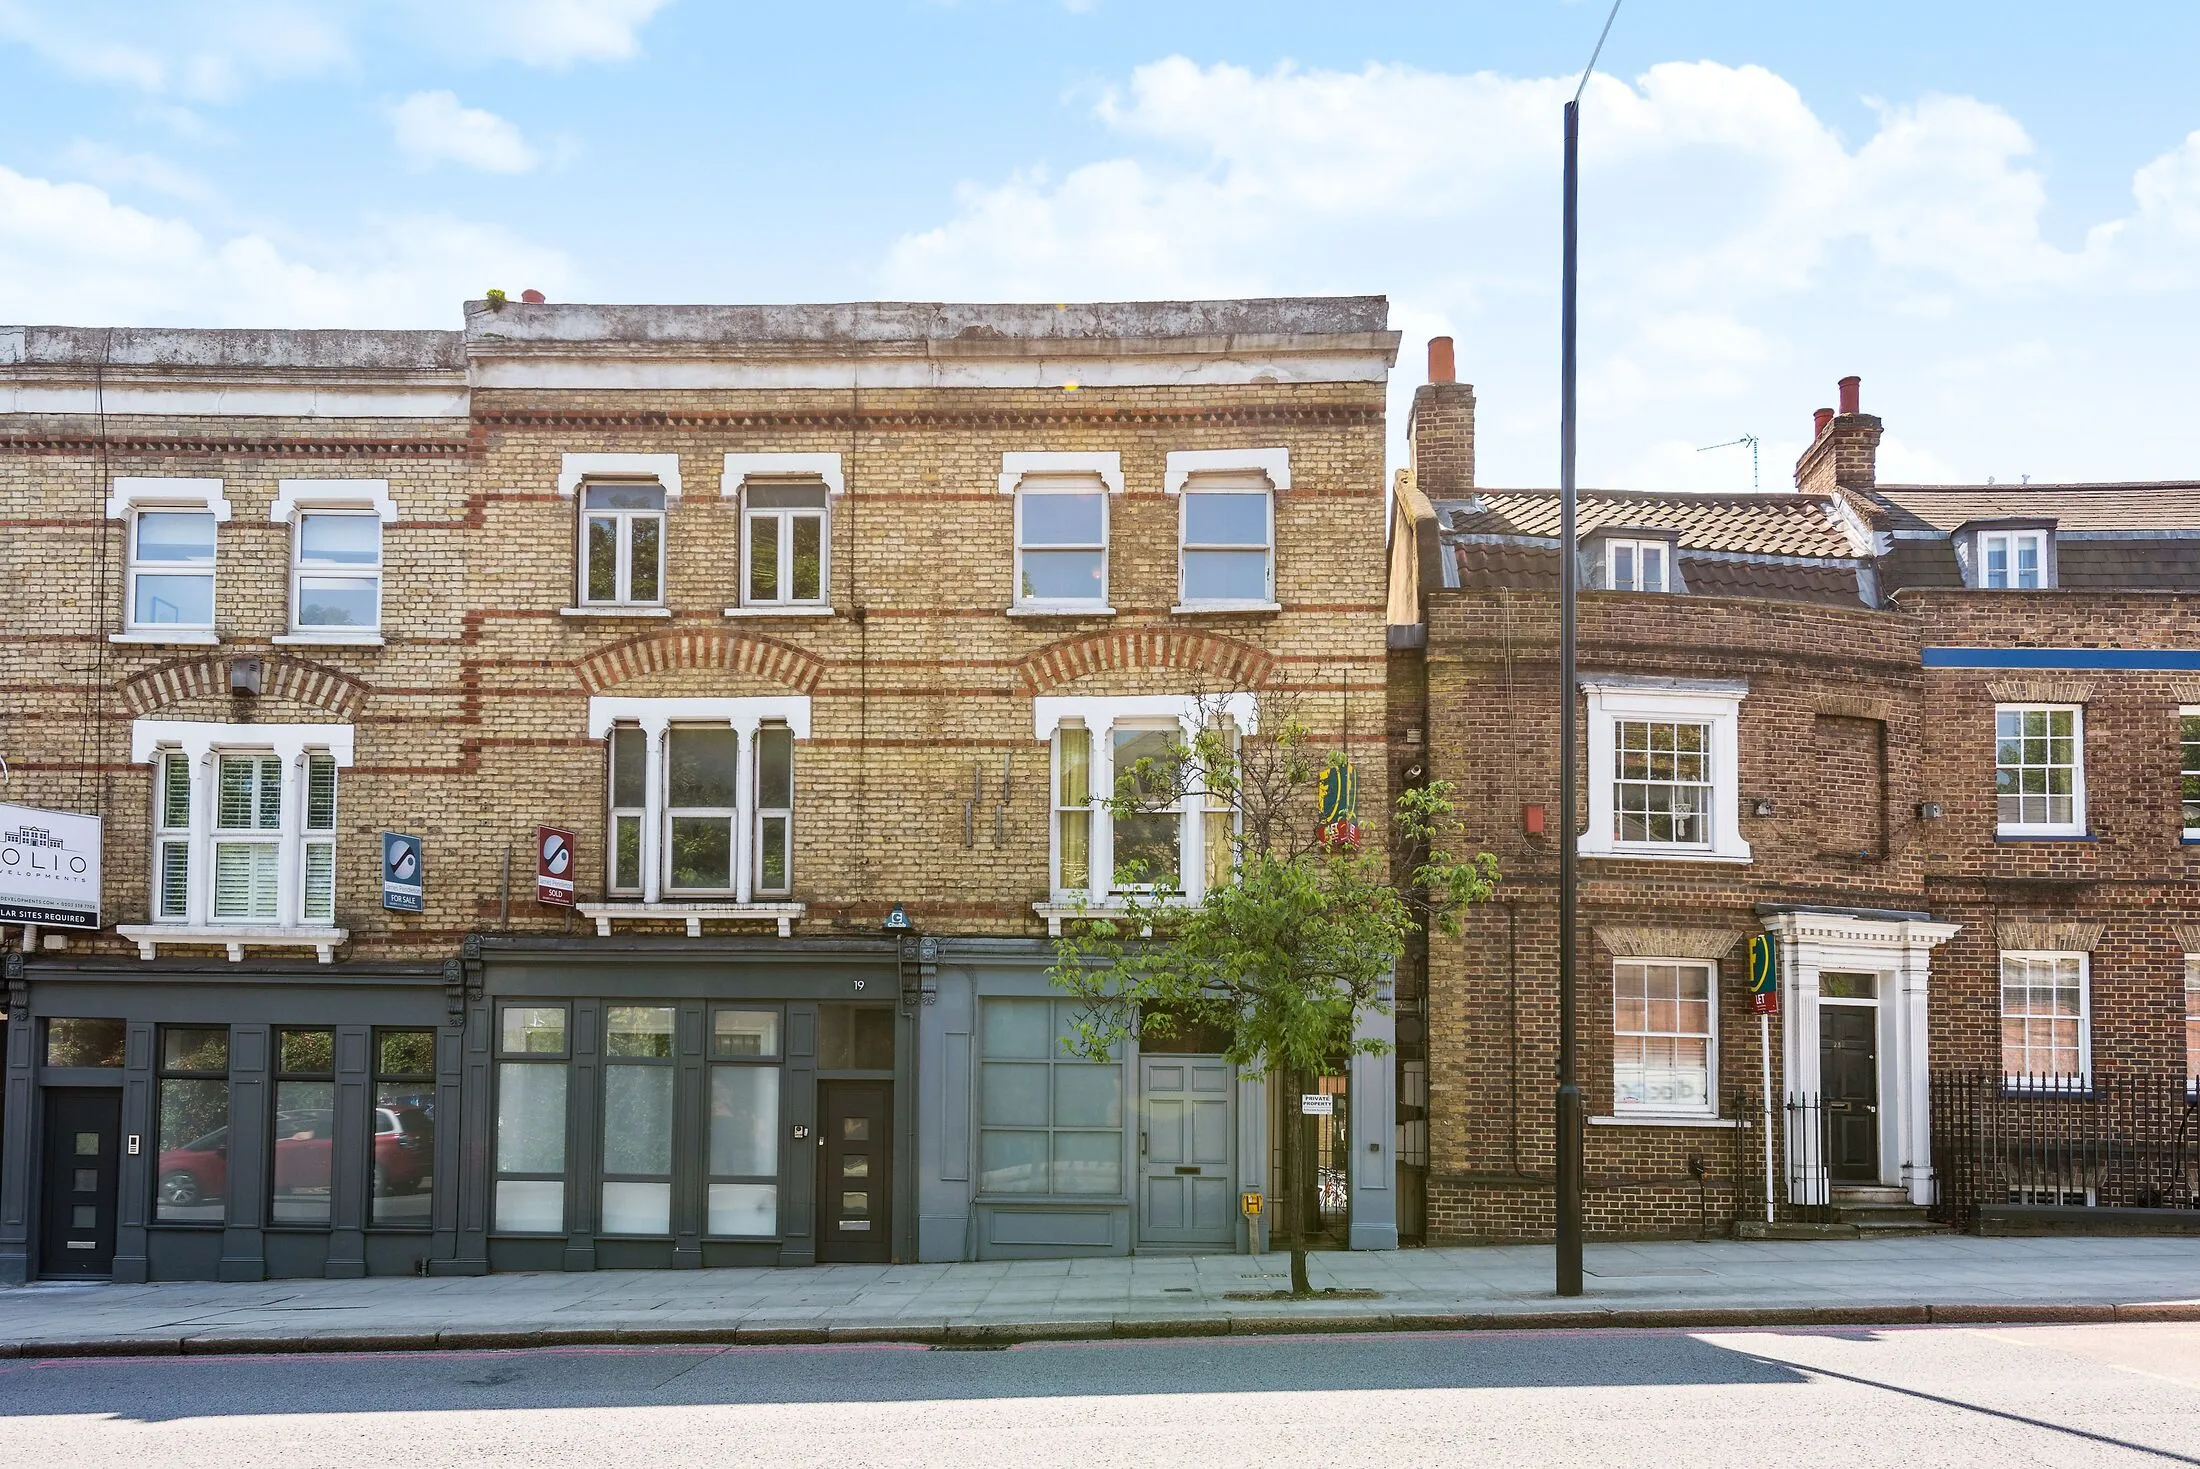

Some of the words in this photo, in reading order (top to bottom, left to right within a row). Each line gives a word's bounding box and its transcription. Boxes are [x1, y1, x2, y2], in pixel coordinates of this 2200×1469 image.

[2, 848, 87, 873] OLIO
[391, 894, 402, 903] FOR
[403, 896, 416, 904] SALE
[548, 889, 563, 897] SOLD
[1, 909, 16, 917] LAR
[19, 910, 42, 919] SITES
[45, 913, 85, 923] REQUIRED
[854, 980, 865, 991] 19
[1755, 993, 1765, 1005] LET
[1246, 1195, 1260, 1212] H
